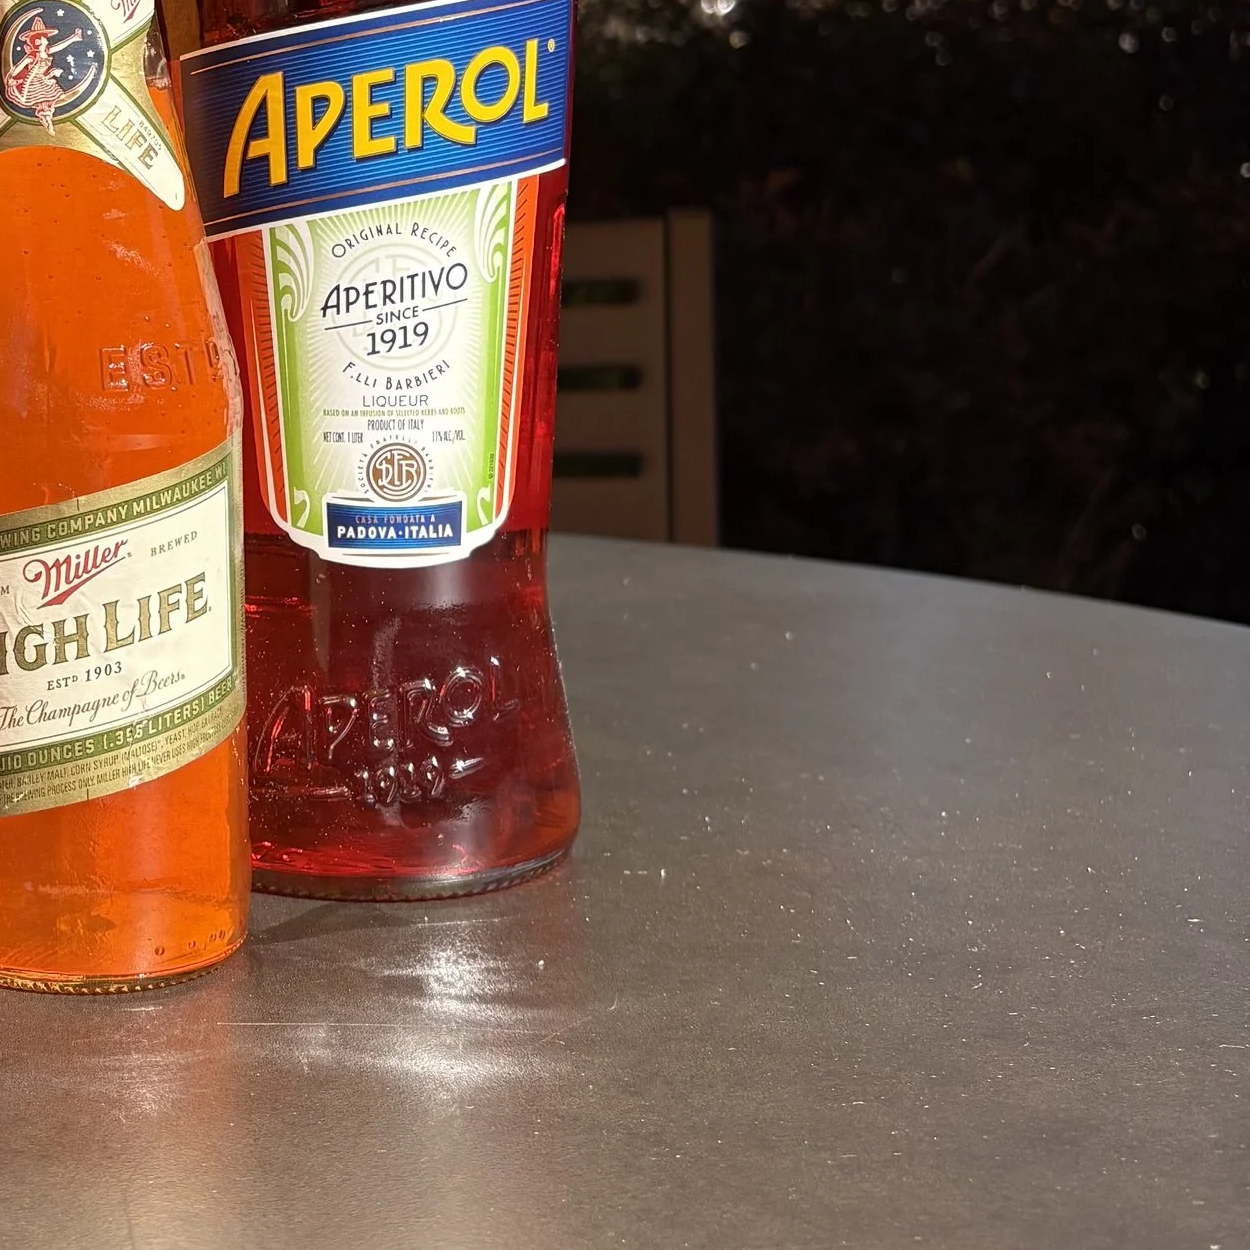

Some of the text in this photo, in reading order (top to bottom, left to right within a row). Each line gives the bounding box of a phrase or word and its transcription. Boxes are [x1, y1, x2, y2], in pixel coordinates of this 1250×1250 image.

[223, 38, 549, 198] APEROL
[102, 105, 159, 170] LIFE
[331, 222, 457, 259] ORIGINAL RECIPE
[320, 262, 468, 318] APERITIVO
[376, 306, 420, 325] SINCE
[366, 321, 429, 356] 1919
[342, 359, 451, 391] F.LLI BARBIERI
[362, 394, 429, 408] LIQUEUR
[367, 418, 425, 431] PRODUCT OF ITALY
[47, 504, 128, 539] COMPANY
[133, 472, 212, 518] MILWAUKEE
[355, 515, 379, 524] CASA
[430, 514, 435, 523] A
[150, 530, 198, 557] BREWED
[23, 539, 129, 610] Miller
[102, 572, 209, 653] LIFE
[85, 661, 123, 682] 1903
[24, 690, 119, 726] Champagne
[121, 679, 139, 711] of
[253, 655, 518, 774] APEROL
[28, 738, 95, 767] OUNCES
[149, 697, 205, 735] LITERS)
[208, 679, 233, 706] BEER
[17, 772, 44, 788] BARLEY
[70, 762, 91, 776] CORN
[94, 754, 119, 770] SYRUP
[47, 780, 77, 798] PROCESS
[96, 769, 120, 785] MILLER
